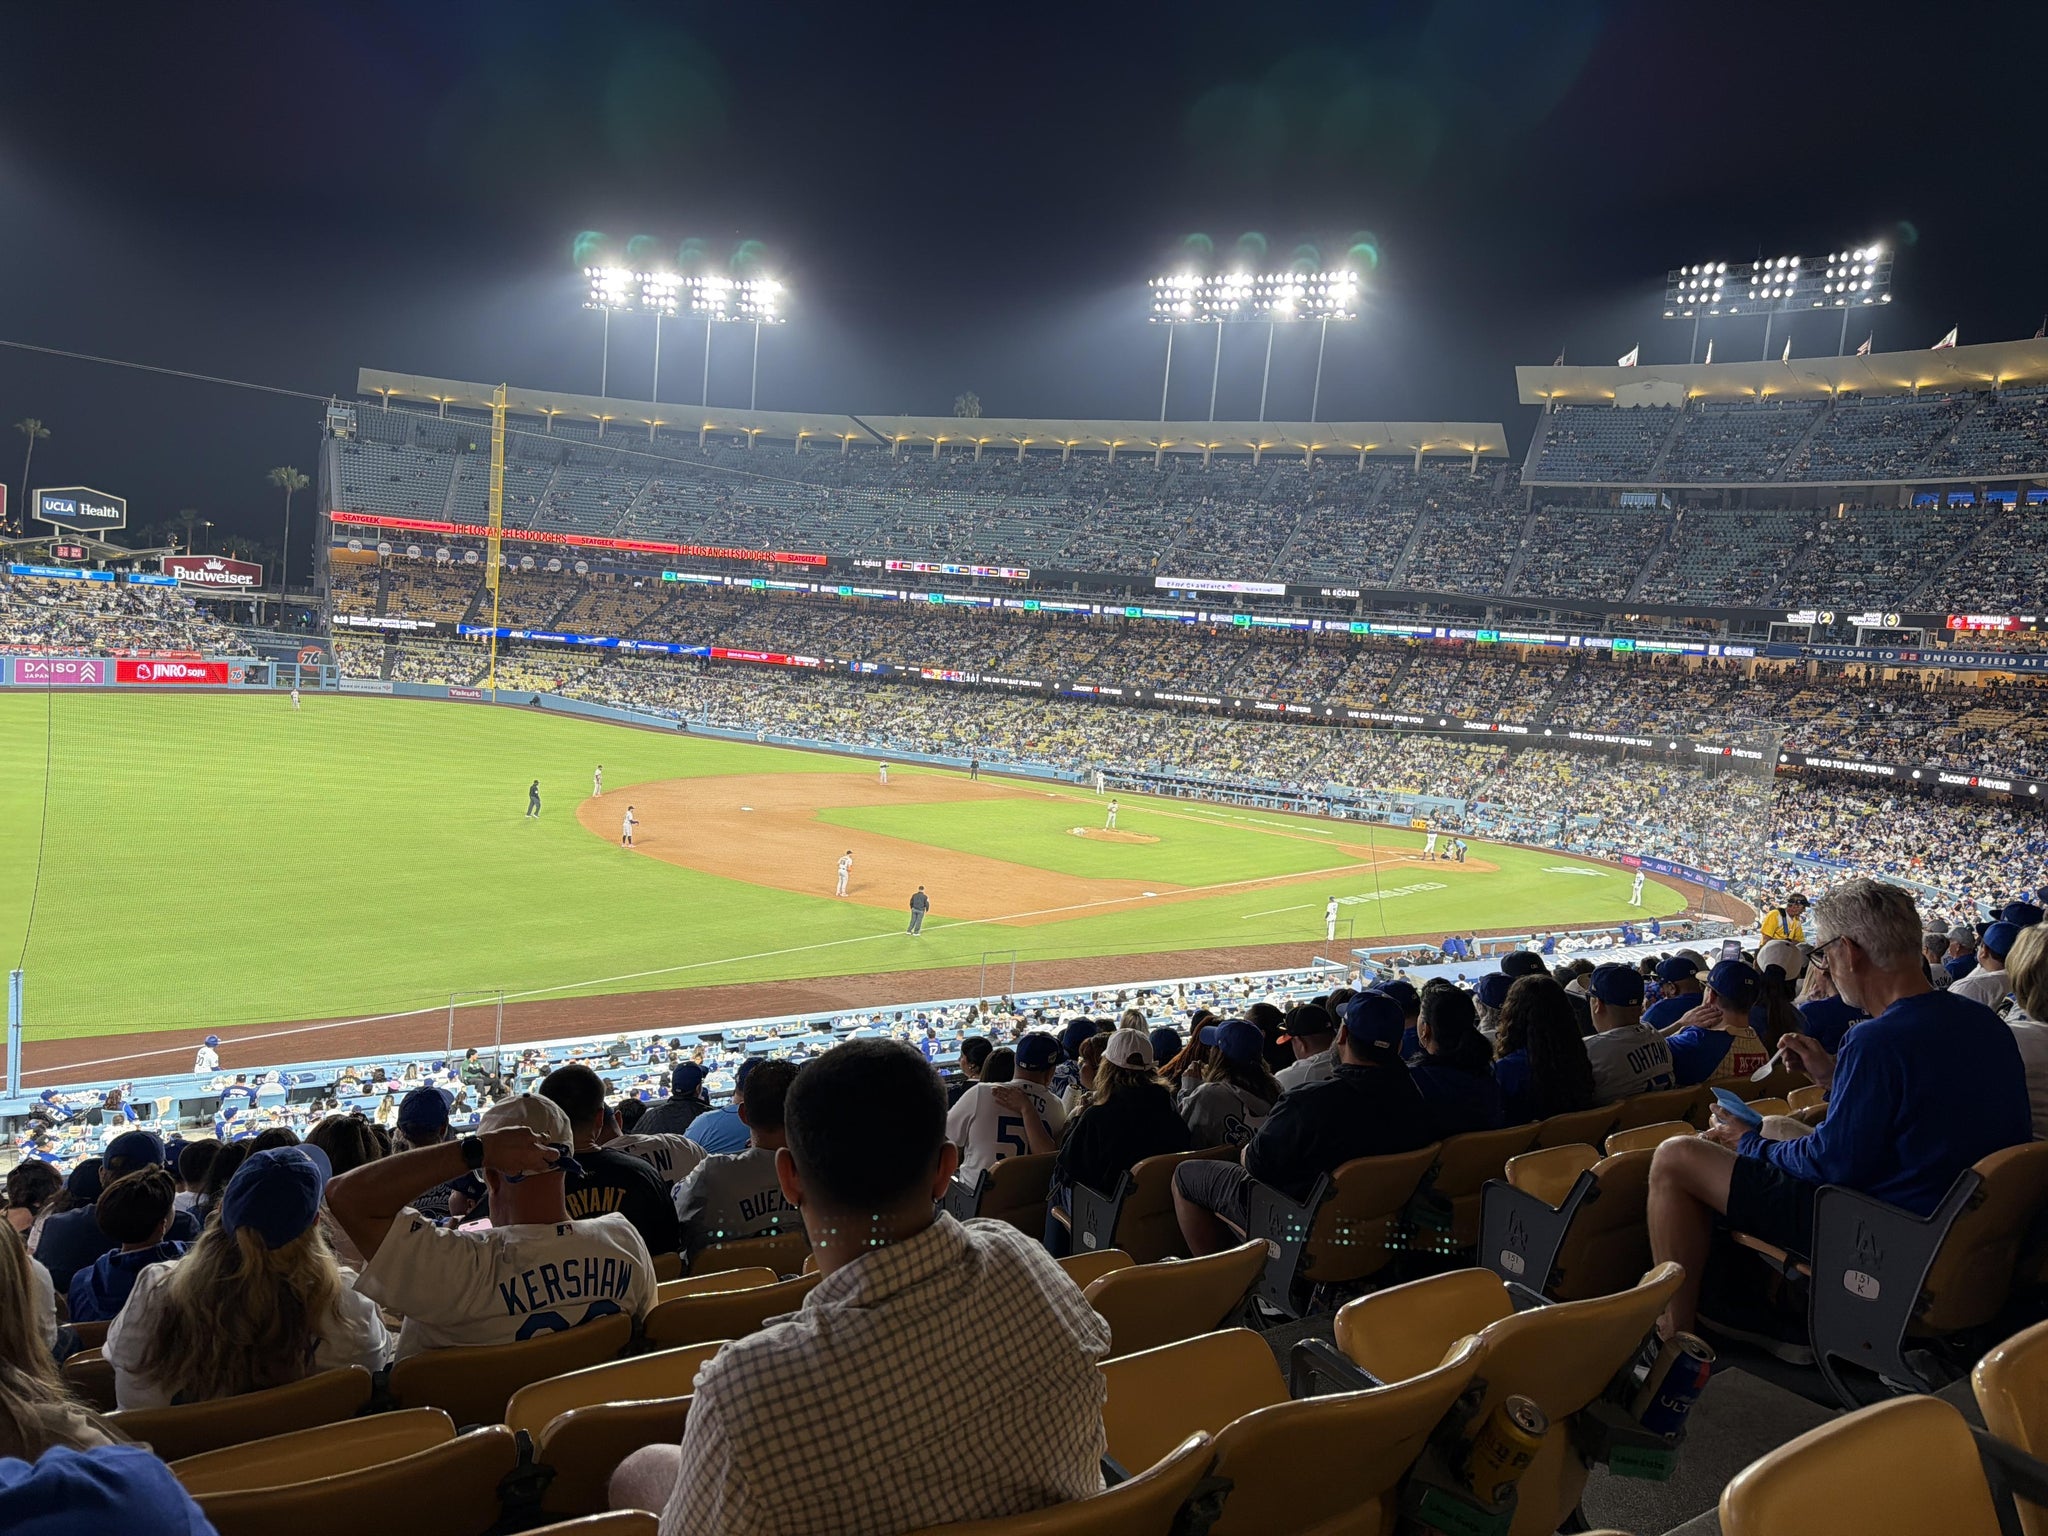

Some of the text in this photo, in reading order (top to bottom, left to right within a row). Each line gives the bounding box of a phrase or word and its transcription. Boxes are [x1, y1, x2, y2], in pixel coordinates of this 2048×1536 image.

[45, 500, 119, 518] UCLA Health
[342, 513, 380, 524] SEATGEEK
[453, 523, 470, 534] THE
[470, 525, 486, 536] LOS
[487, 526, 525, 539] ANGELES
[526, 529, 567, 543] DODGERS
[581, 537, 614, 547] SEATGEEK
[693, 546, 707, 556] LOS
[707, 547, 740, 559] ANGELES
[740, 549, 776, 561] DODGERS
[787, 554, 817, 563] SEATGEEK
[302, 652, 320, 665] 76
[1813, 648, 1894, 659] WELCOME TO
[1924, 653, 1975, 664] UNIQLO
[1980, 656, 2016, 666] FIELD
[2022, 658, 2038, 667] AT
[24, 662, 77, 673] DAISO
[152, 664, 187, 680] JINRO
[230, 671, 242, 679] 76
[450, 688, 481, 698] Yakult
[1394, 715, 1408, 723] FOR
[1409, 716, 1424, 724] YOU
[1568, 731, 1581, 740] WE
[1594, 733, 1604, 741] TO
[1605, 735, 1620, 744] BAT
[1620, 736, 1636, 745] FOR
[1636, 738, 1652, 747] YOU
[1805, 757, 1895, 776] WE GO TO BAT FOR YOU
[929, 1046, 938, 1056] 17
[566, 1186, 628, 1219] RYANT
[1854, 1272, 1870, 1285] 151
[499, 1257, 632, 1316] KERSHAW
[1857, 1284, 1864, 1293] K
